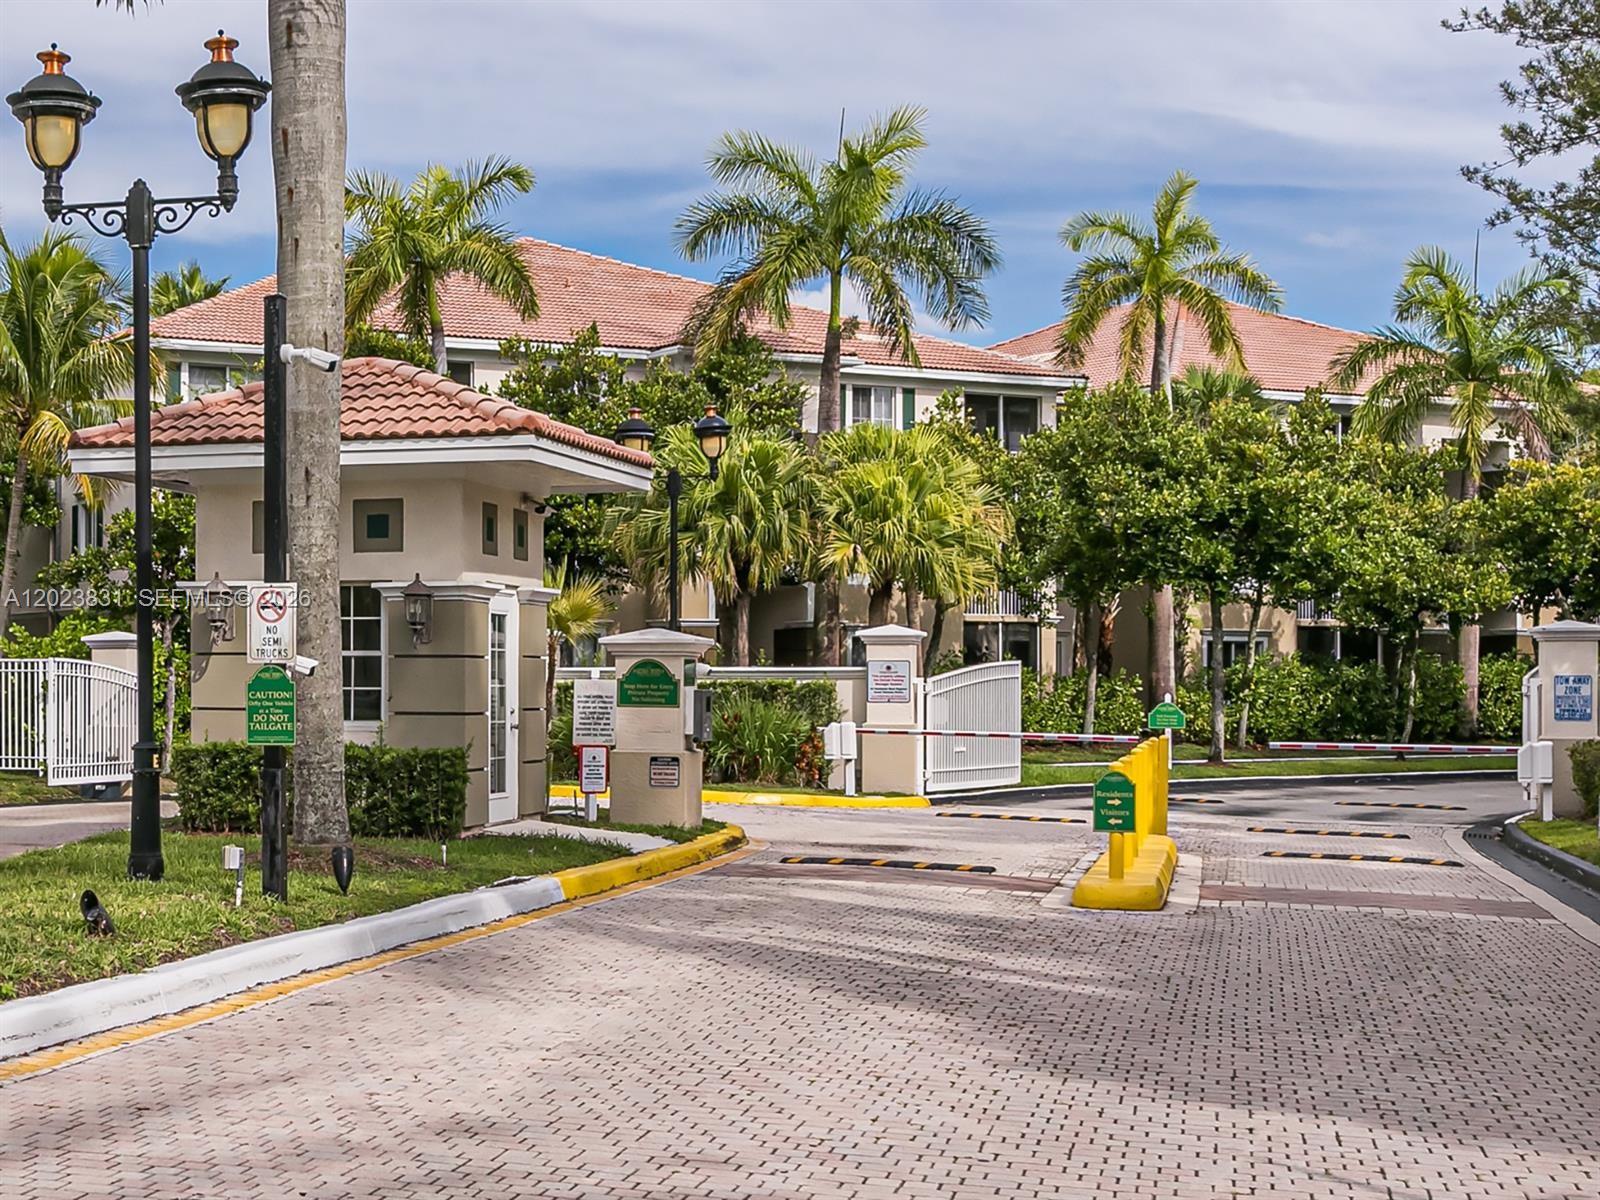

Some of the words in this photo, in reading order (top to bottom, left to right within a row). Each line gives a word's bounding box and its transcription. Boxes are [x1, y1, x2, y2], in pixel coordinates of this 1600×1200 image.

[266, 625, 278, 635] NO
[262, 637, 282, 647] SEMI
[256, 648, 289, 658] TRUCKS
[1564, 685, 1582, 695] ZONE
[249, 691, 293, 699] CAUTION!
[253, 714, 267, 722] DO
[269, 714, 289, 722] NOT
[249, 722, 294, 731] TAILGATE
[1096, 790, 1133, 798] Residents
[1099, 808, 1130, 816] Visitors
